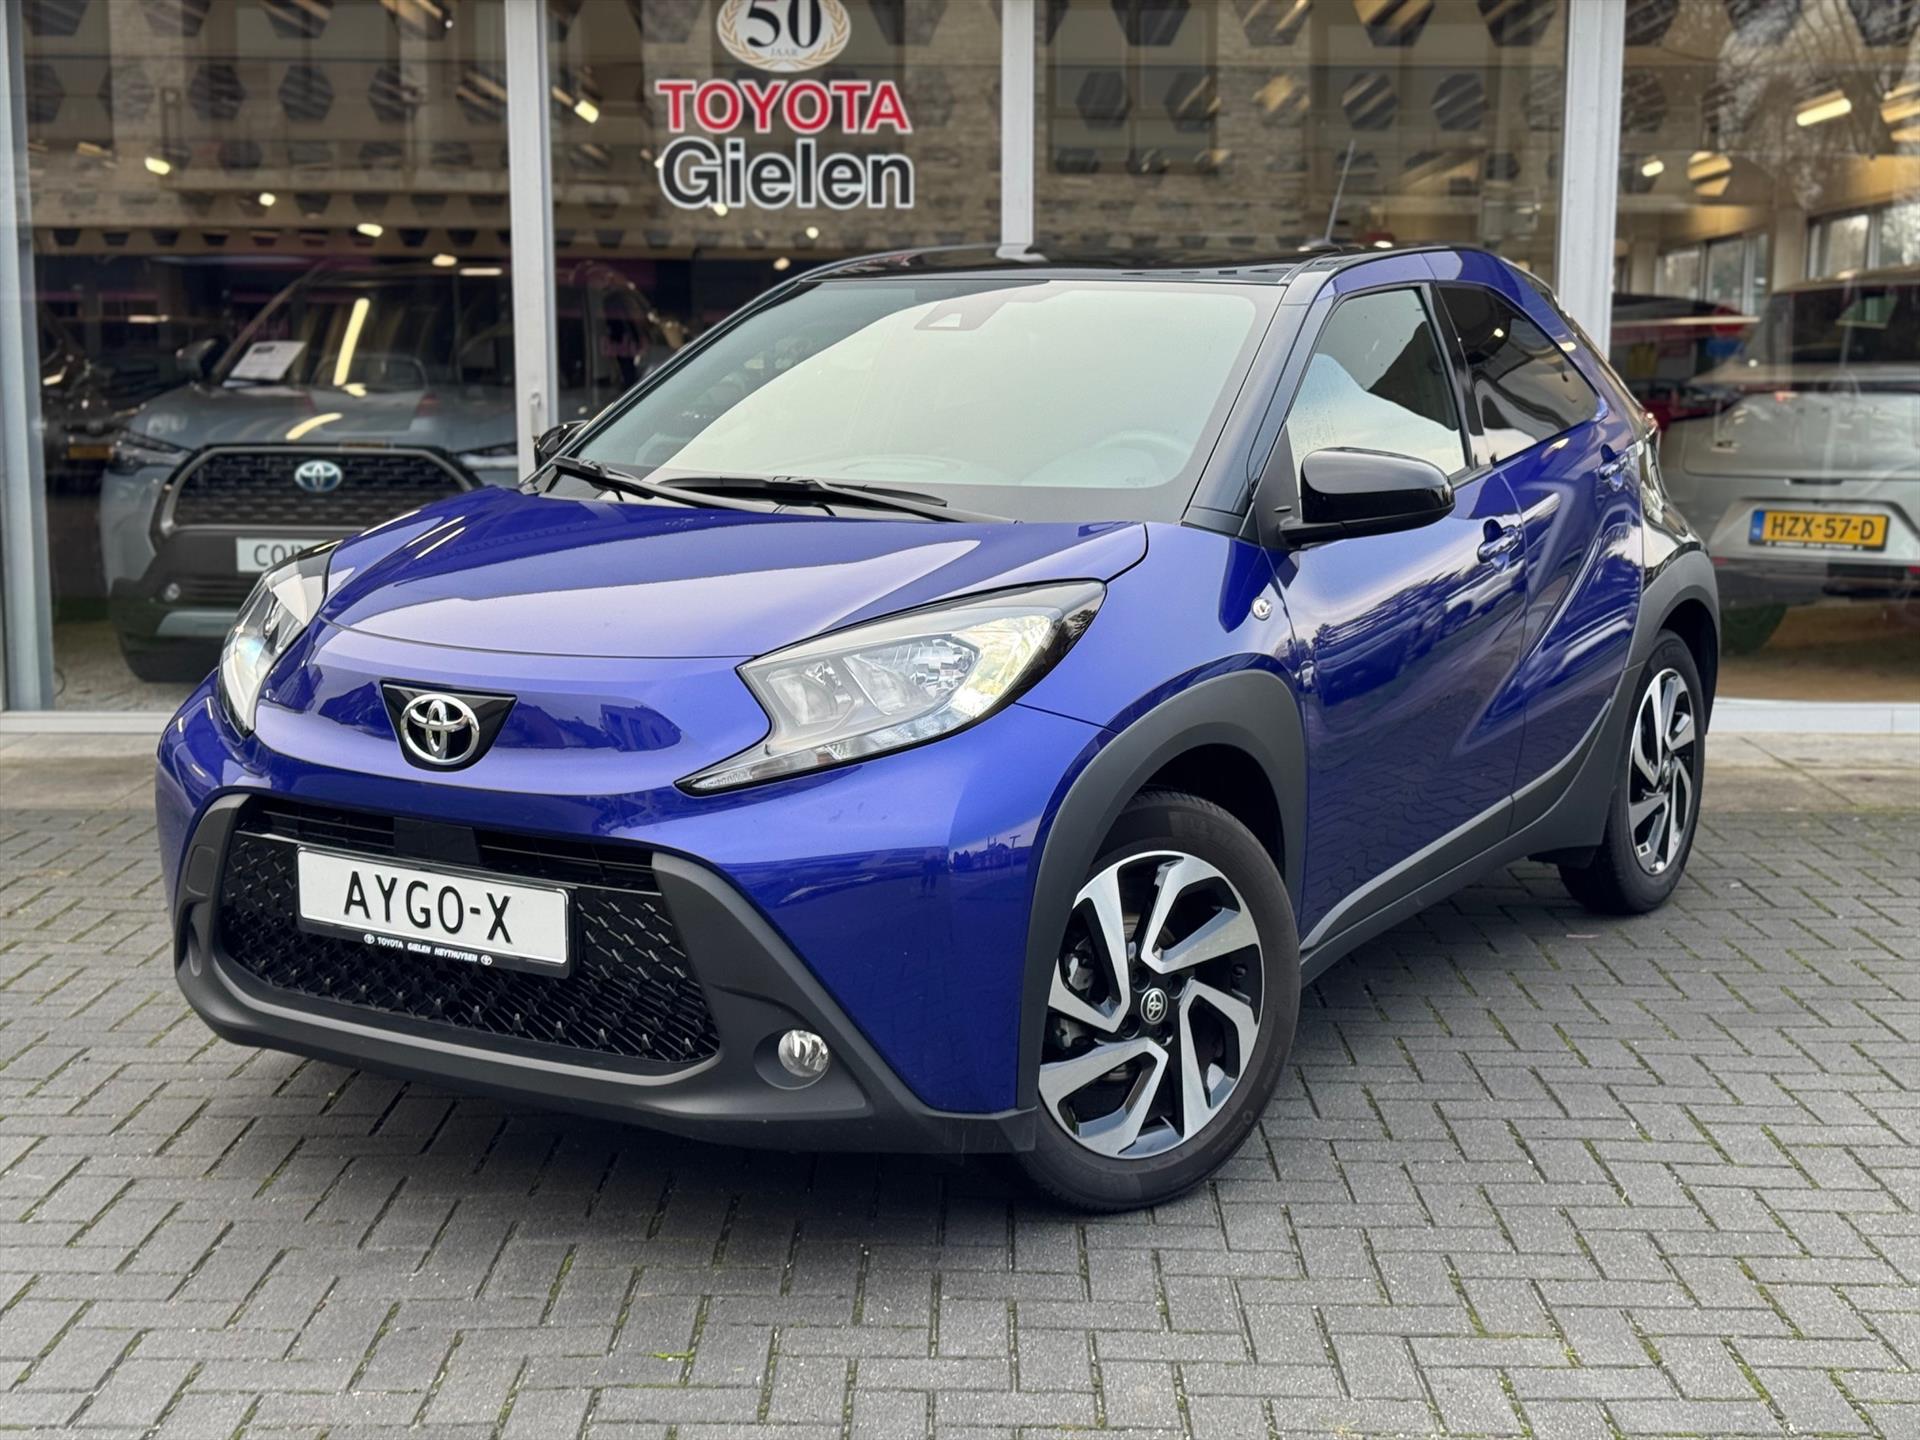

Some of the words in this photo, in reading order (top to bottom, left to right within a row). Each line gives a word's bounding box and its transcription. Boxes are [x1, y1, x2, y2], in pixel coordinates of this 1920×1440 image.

[747, 0, 822, 48] 50
[770, 48, 799, 57] JAAR
[656, 80, 912, 134] TOYOTA
[659, 136, 914, 209] Gielen
[1770, 515, 1876, 541] HZX-57-D
[343, 870, 513, 944] AYGO-X
[377, 936, 404, 949] TOYOTA
[407, 942, 432, 954] GIELEN
